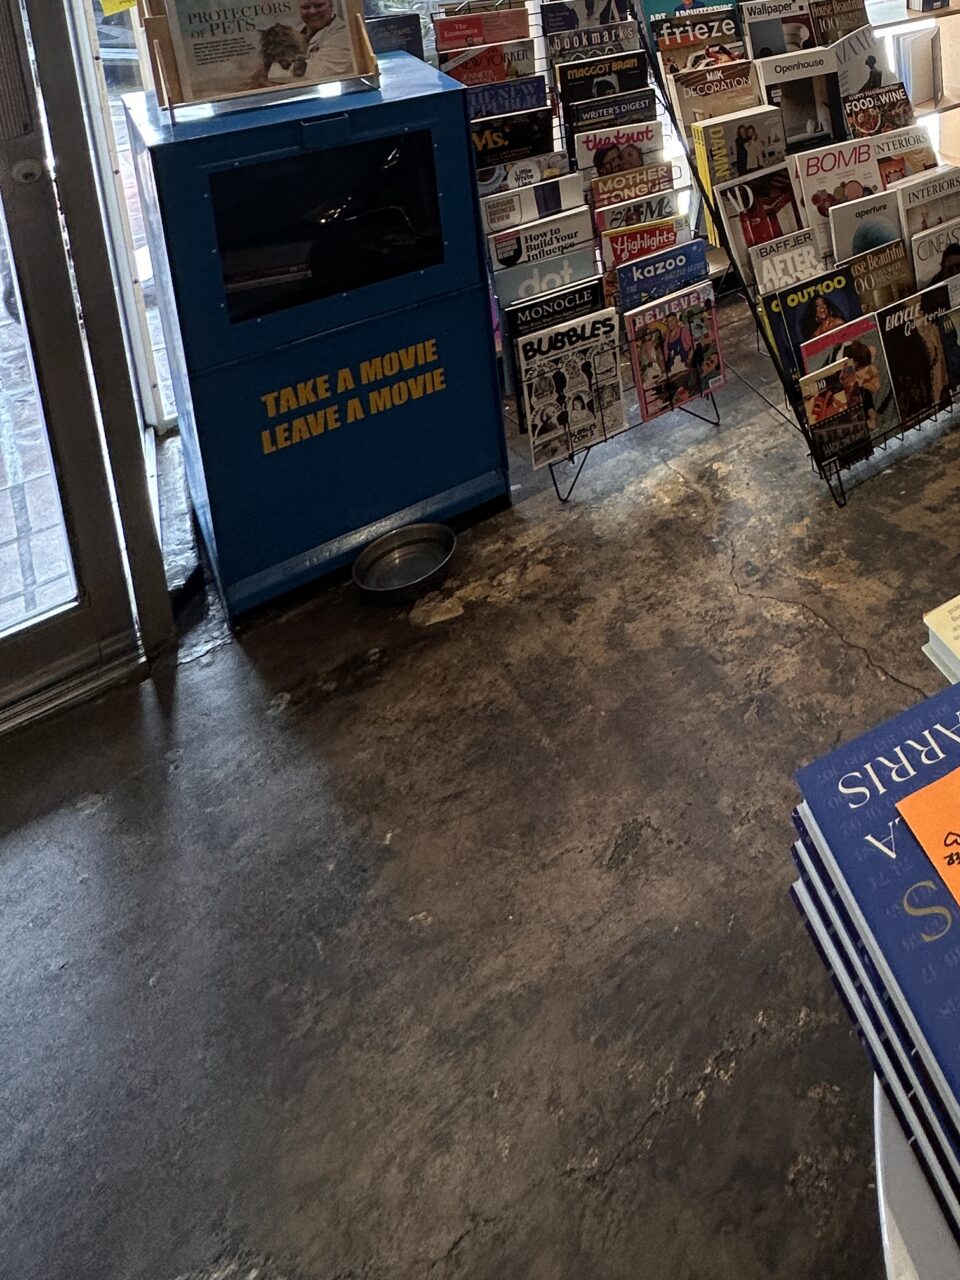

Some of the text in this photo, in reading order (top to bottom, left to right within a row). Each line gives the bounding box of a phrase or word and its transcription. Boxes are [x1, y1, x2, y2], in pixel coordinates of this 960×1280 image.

[187, 0, 293, 25] PROTECTORS
[209, 19, 256, 38] PETS
[444, 27, 478, 38] Economist
[552, 26, 634, 50] bookmarks
[660, 19, 736, 46] frieze
[567, 58, 638, 80] MAGGOT BRAIN
[774, 57, 825, 74] Openhouse
[683, 74, 751, 98] DECORATION
[581, 99, 650, 120] WRITER'S DIGEST
[582, 125, 655, 151] the knot
[874, 131, 928, 155] INTERIORS
[806, 144, 871, 177] BOMB
[598, 165, 668, 194] MOTHER
[907, 177, 960, 204] INTERIORS
[599, 181, 671, 206] TONGUE
[854, 202, 888, 219] aperture
[524, 226, 561, 245] How to
[525, 231, 579, 254] Build Your
[612, 230, 676, 261] Highlights
[526, 241, 576, 264] Influence
[518, 258, 574, 298] dot
[632, 253, 687, 282] kazoo
[786, 275, 846, 307] OUT100
[516, 289, 593, 324] MONOCLE
[885, 304, 921, 331] BICYCLE
[904, 307, 947, 337] Quarterly
[521, 316, 616, 361] BUBBLES
[261, 338, 439, 418] TAKE A MOVIE
[261, 367, 446, 455] LEAVE A MOVIE
